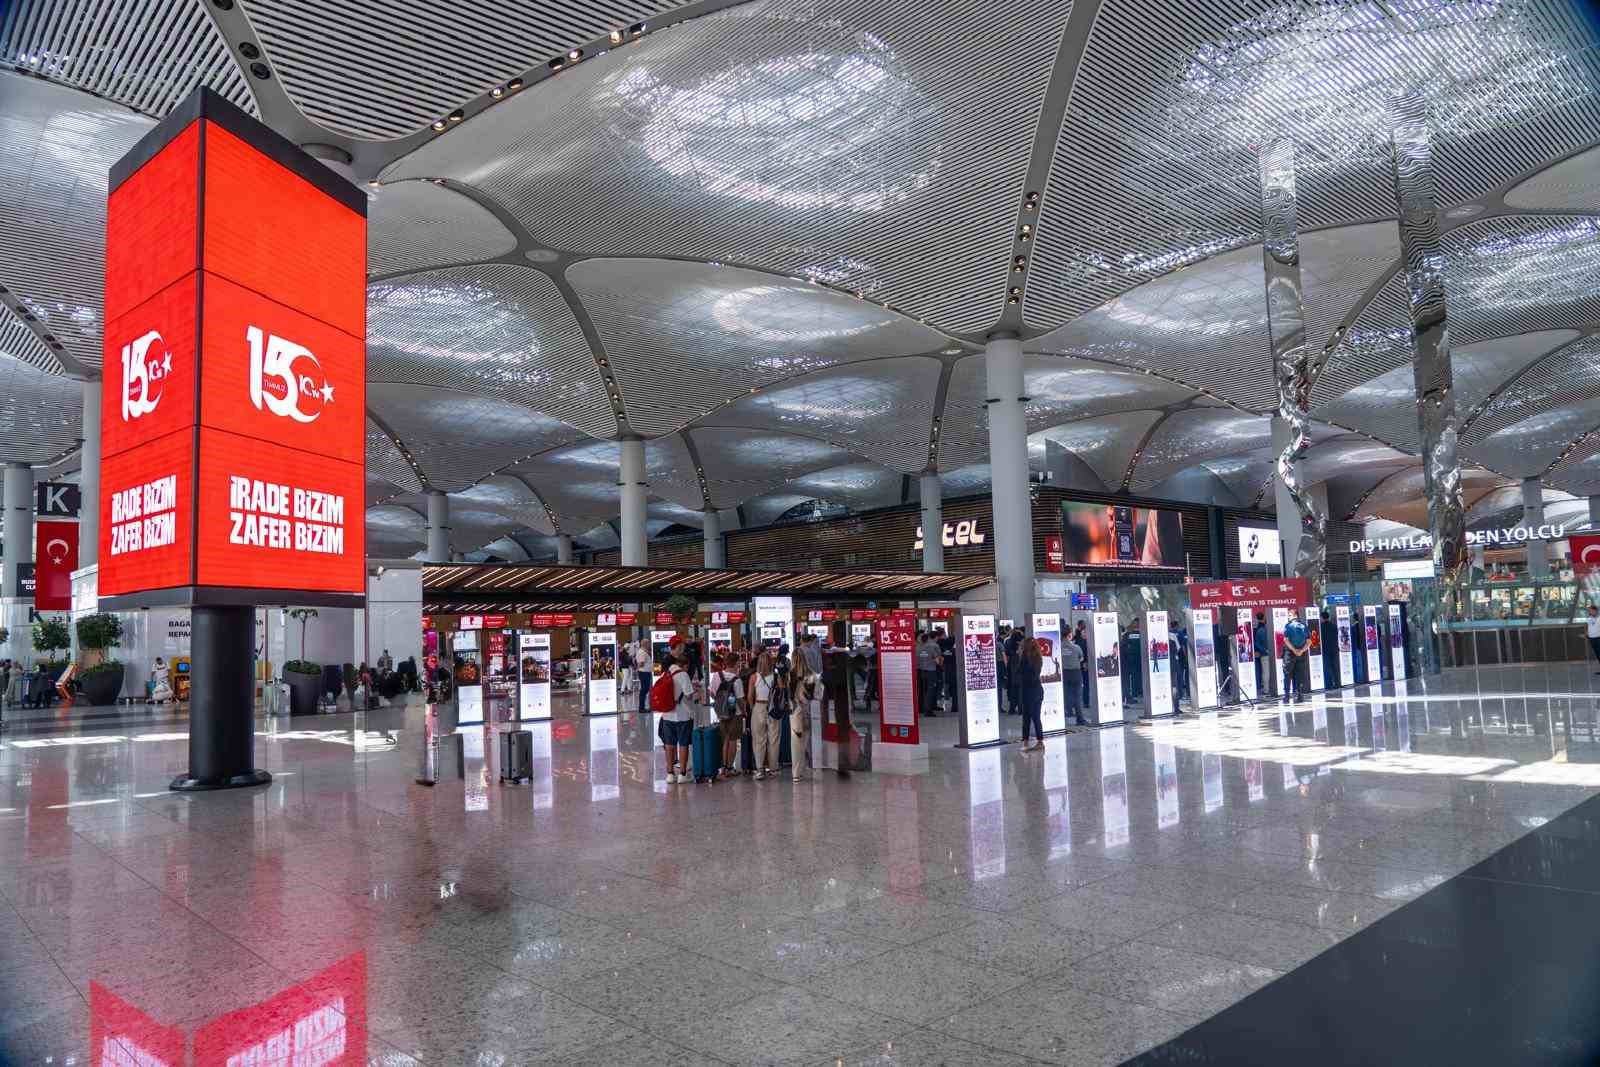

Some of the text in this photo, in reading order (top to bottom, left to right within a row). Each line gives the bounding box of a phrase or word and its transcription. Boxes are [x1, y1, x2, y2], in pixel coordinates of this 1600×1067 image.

[46, 486, 69, 513] K
[293, 487, 344, 525] BİZİM
[111, 520, 143, 556] ZAFER
[229, 511, 344, 556] ZAFER BİZİM
[1349, 540, 1375, 554] DIŞ
[1464, 530, 1499, 545] DEN
[1500, 524, 1564, 541] YOLCU
[168, 620, 191, 628] BAGA
